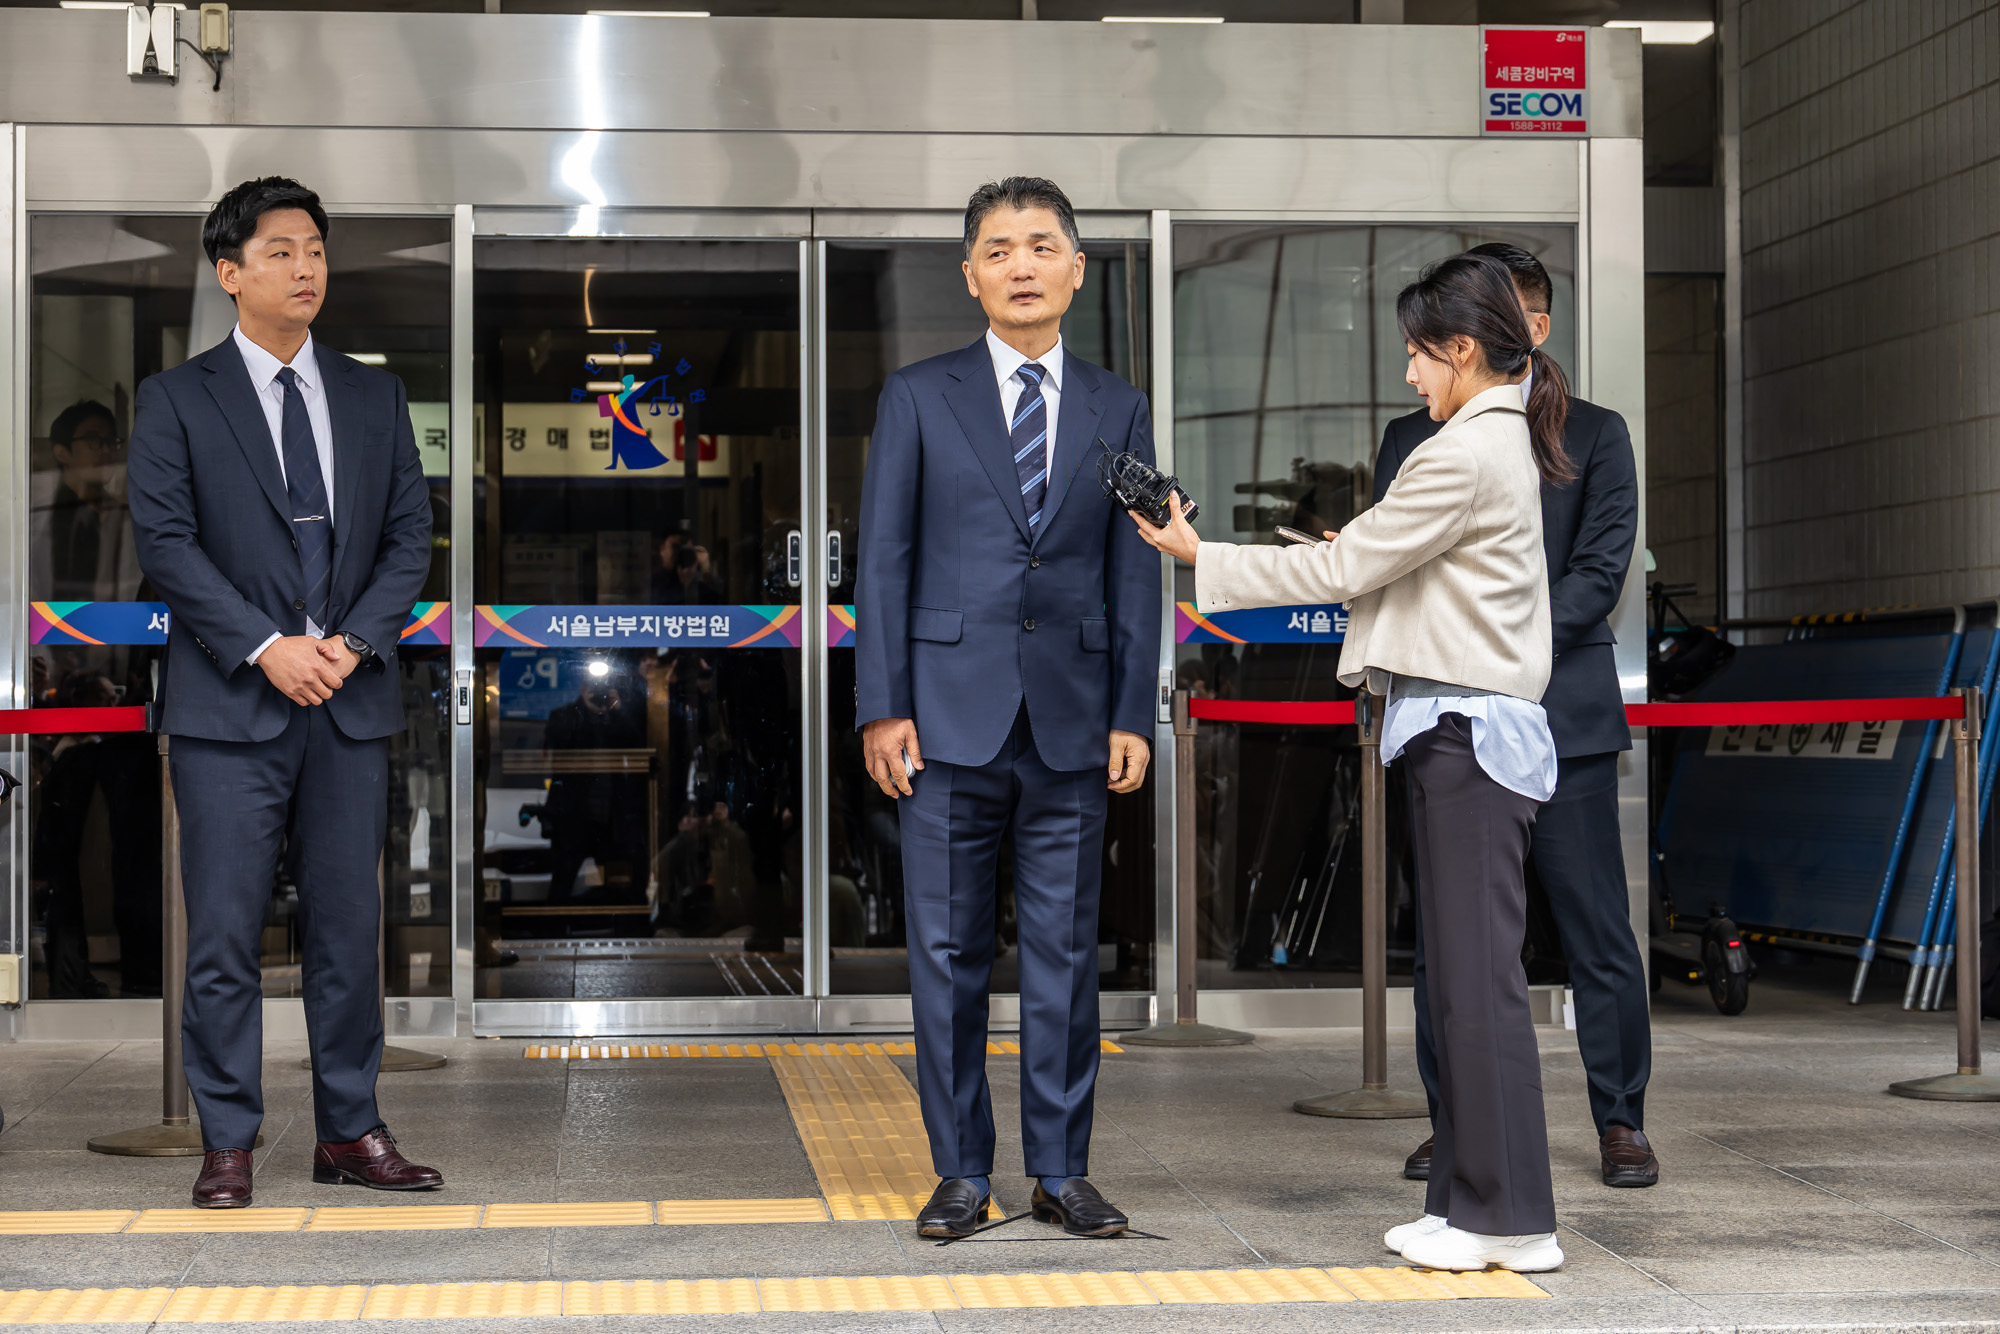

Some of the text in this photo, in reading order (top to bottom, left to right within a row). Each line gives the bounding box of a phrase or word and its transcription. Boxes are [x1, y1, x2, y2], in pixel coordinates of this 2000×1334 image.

[1495, 66, 1575, 82] 세콤경비구역
[1489, 92, 1582, 116] SECOM
[1510, 121, 1562, 131] 1588-3112
[505, 428, 652, 452] 경매법
[547, 614, 730, 638] 서울남부지방법원
